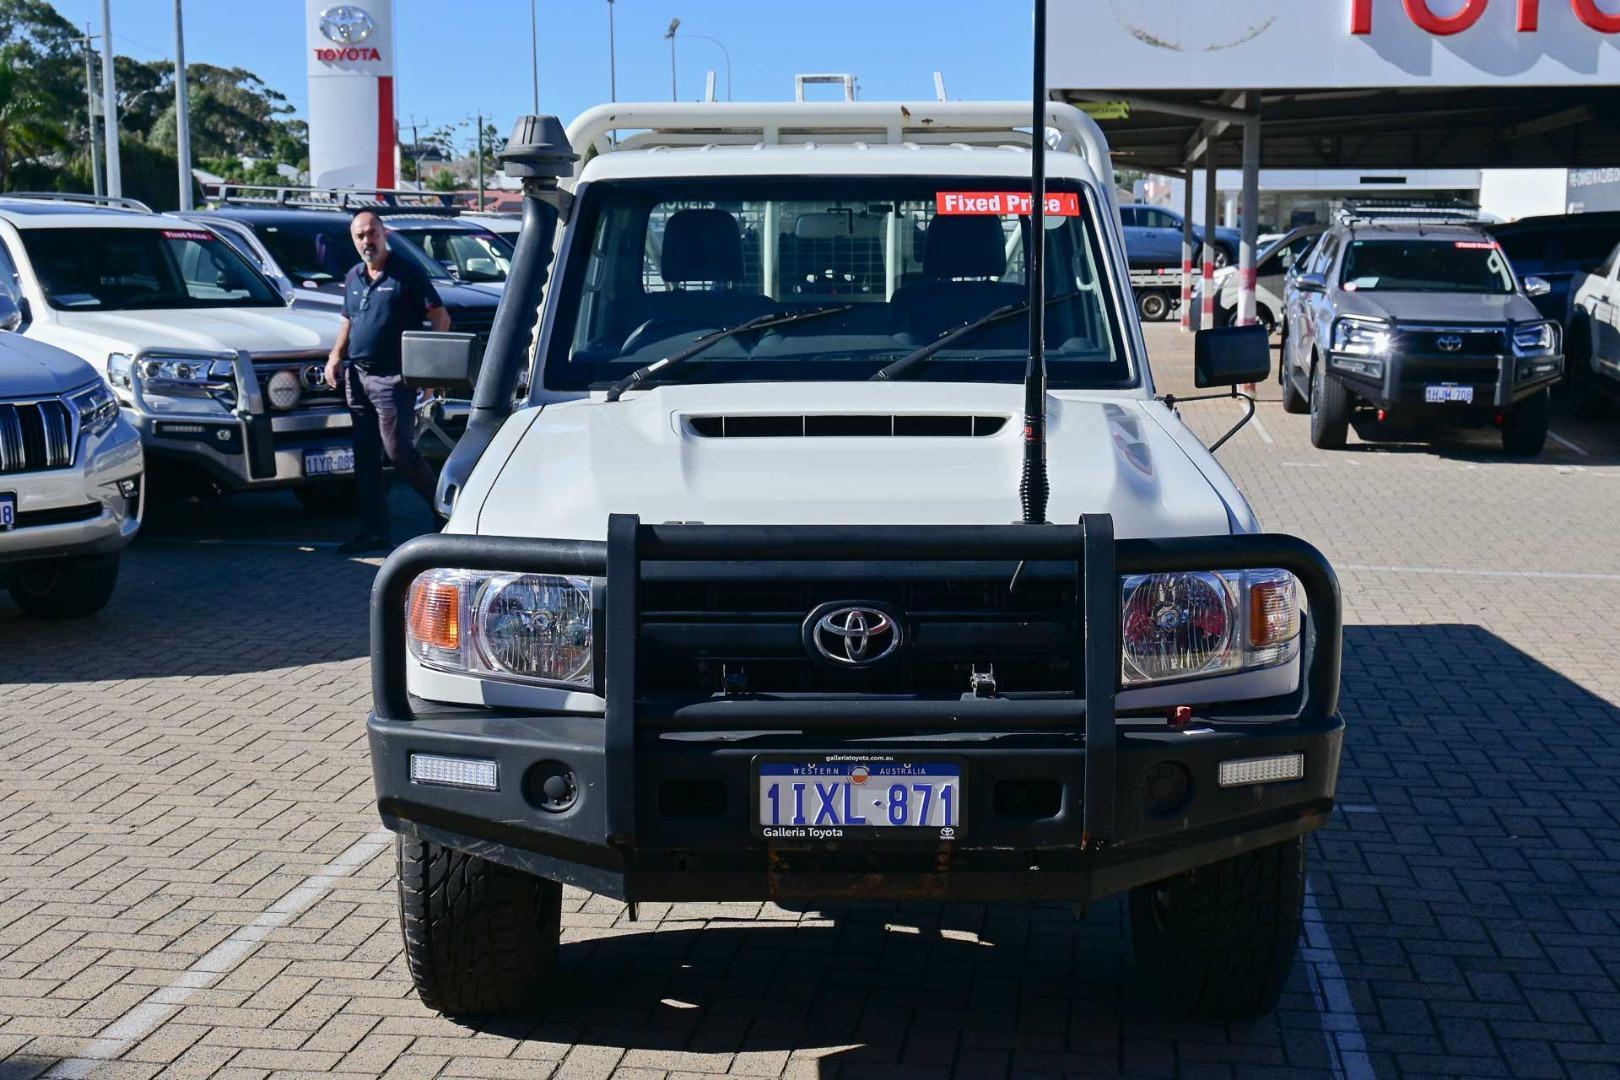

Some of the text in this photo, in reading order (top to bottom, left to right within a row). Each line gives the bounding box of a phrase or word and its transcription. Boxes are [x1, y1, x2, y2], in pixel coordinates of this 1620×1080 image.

[313, 47, 381, 61] TOYOTA
[945, 195, 1060, 212] Fixed Prie
[825, 754, 894, 762] galleriatoyota.com.au
[793, 767, 927, 775] WESTERN AUSTRALIA
[763, 828, 843, 839] Galleria Toyota
